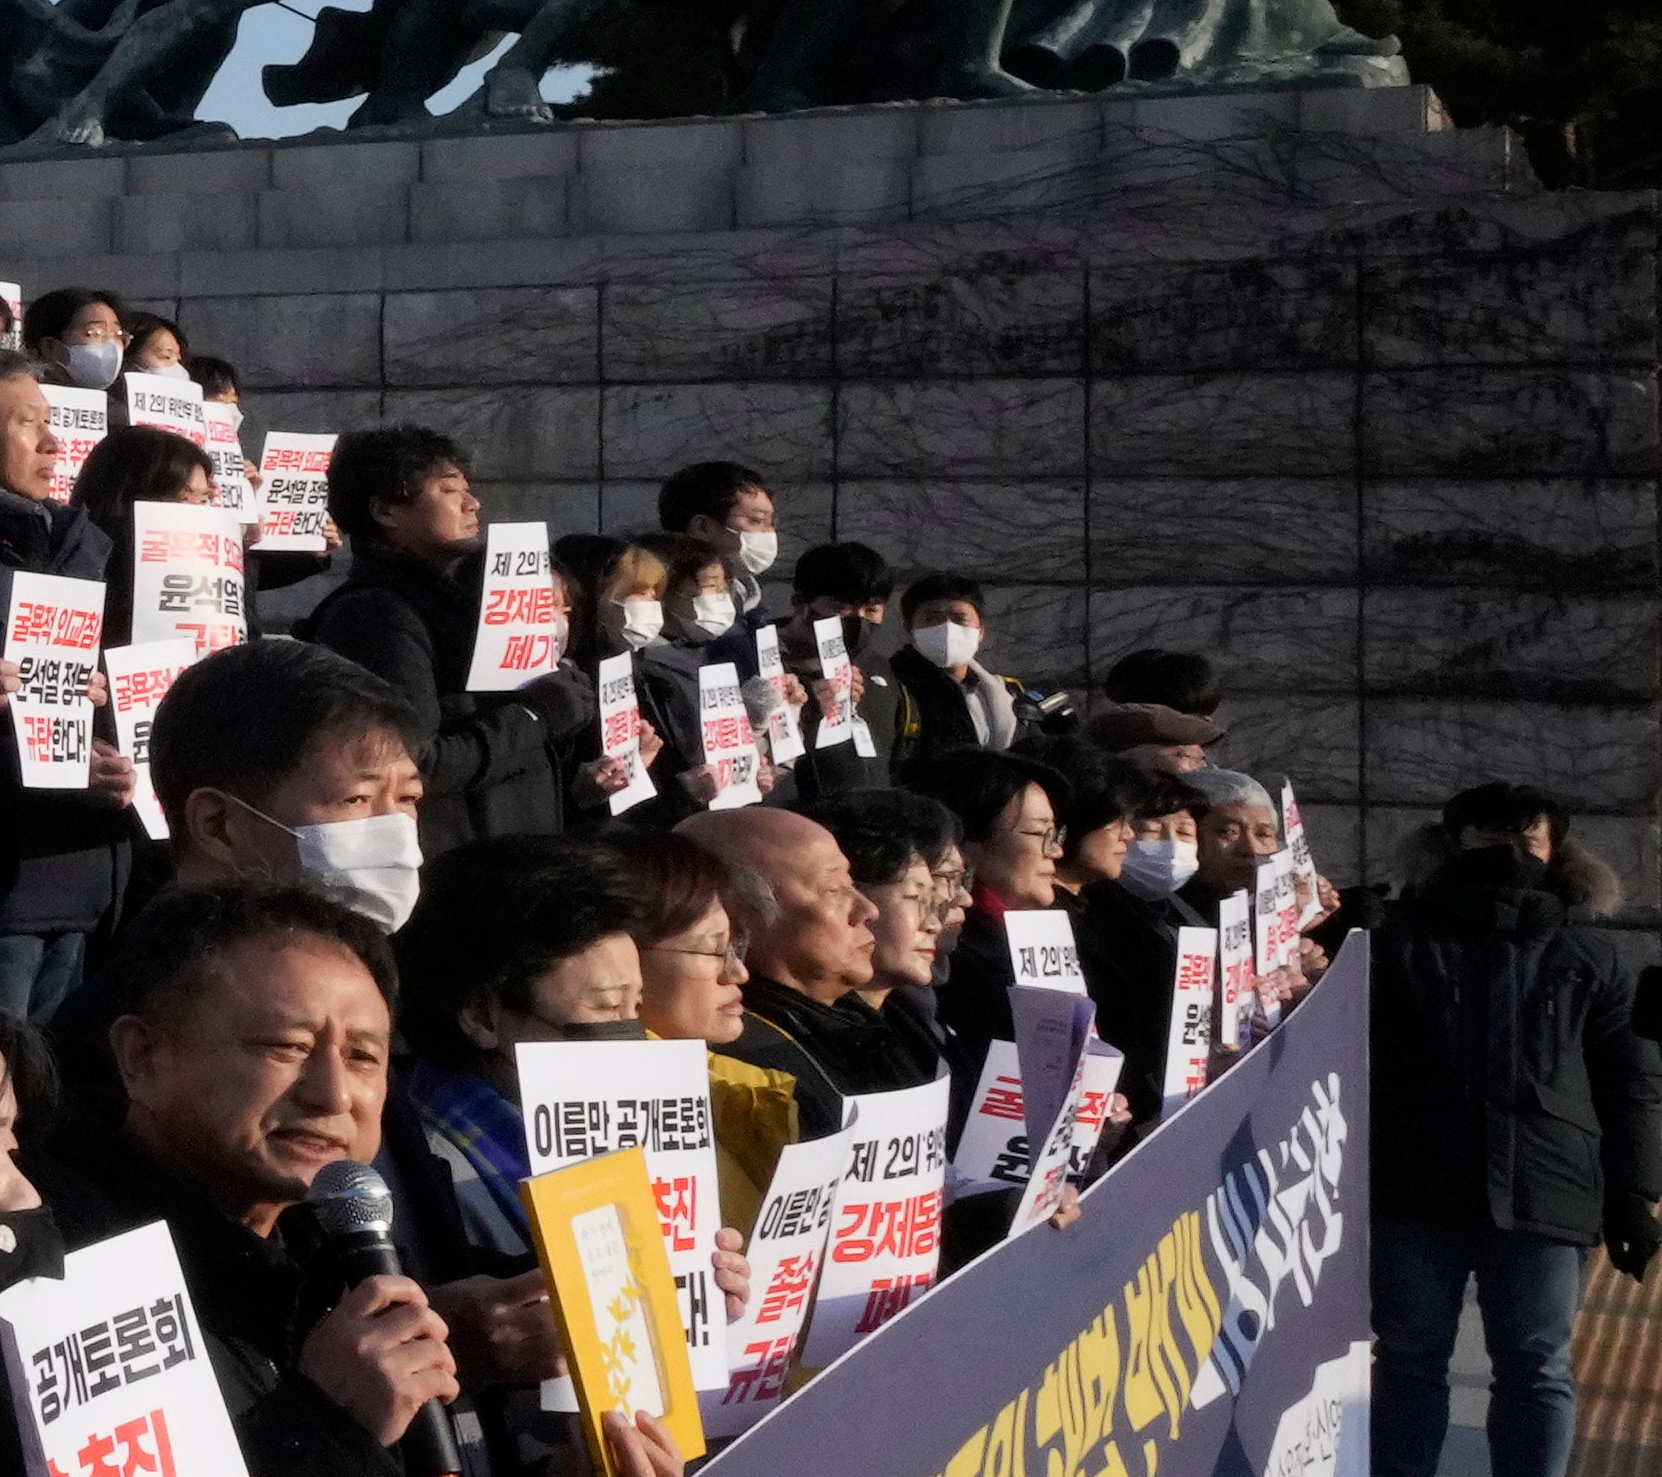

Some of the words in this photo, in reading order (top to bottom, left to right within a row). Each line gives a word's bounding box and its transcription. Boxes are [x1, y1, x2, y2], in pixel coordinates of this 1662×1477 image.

[12, 602, 57, 645] 굴욕적
[24, 716, 86, 763] 규탄한다!
[534, 1100, 609, 1158] 이름만
[616, 1096, 710, 1152] 공개토론회
[845, 1141, 878, 1182] 제
[759, 1189, 820, 1242] 이름만
[32, 1292, 197, 1427] 공개토론회
